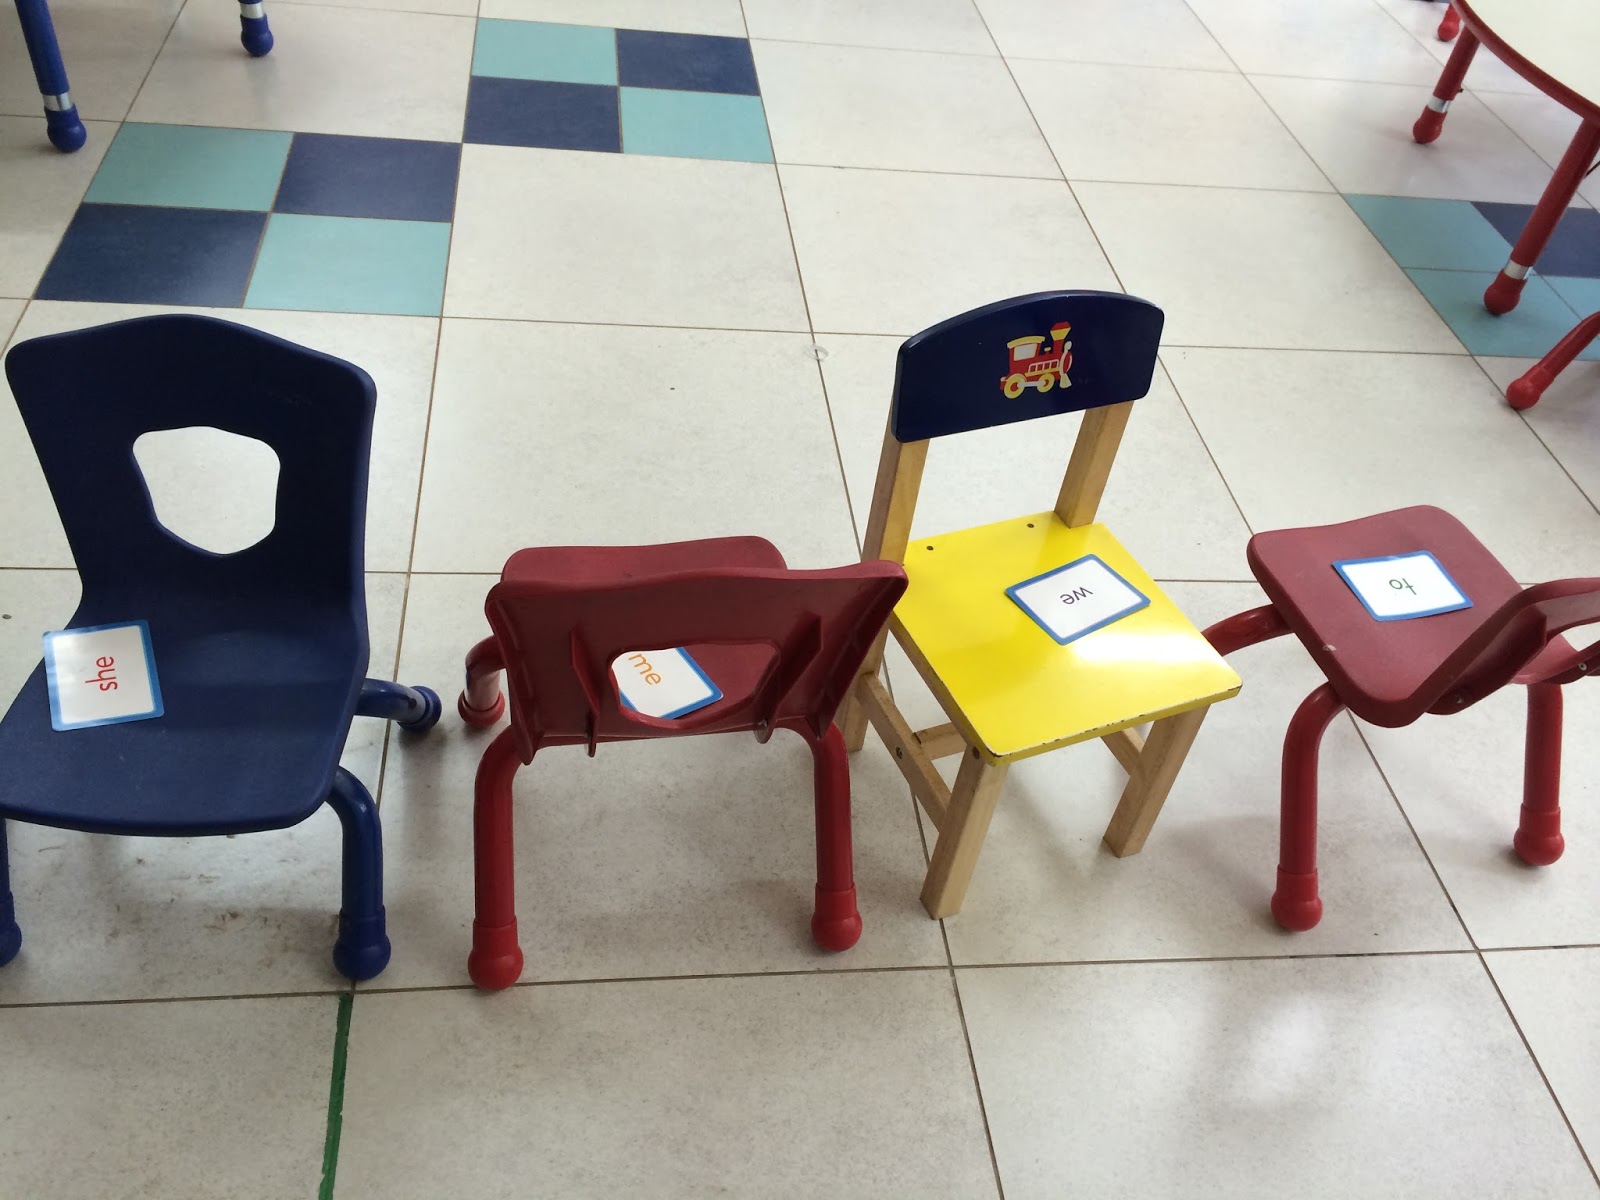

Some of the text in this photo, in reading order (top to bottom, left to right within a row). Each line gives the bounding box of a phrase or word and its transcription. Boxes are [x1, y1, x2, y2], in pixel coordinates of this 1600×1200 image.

[1059, 586, 1094, 605] we
[1388, 577, 1417, 595] to
[84, 656, 118, 691] she
[628, 653, 662, 685] me
